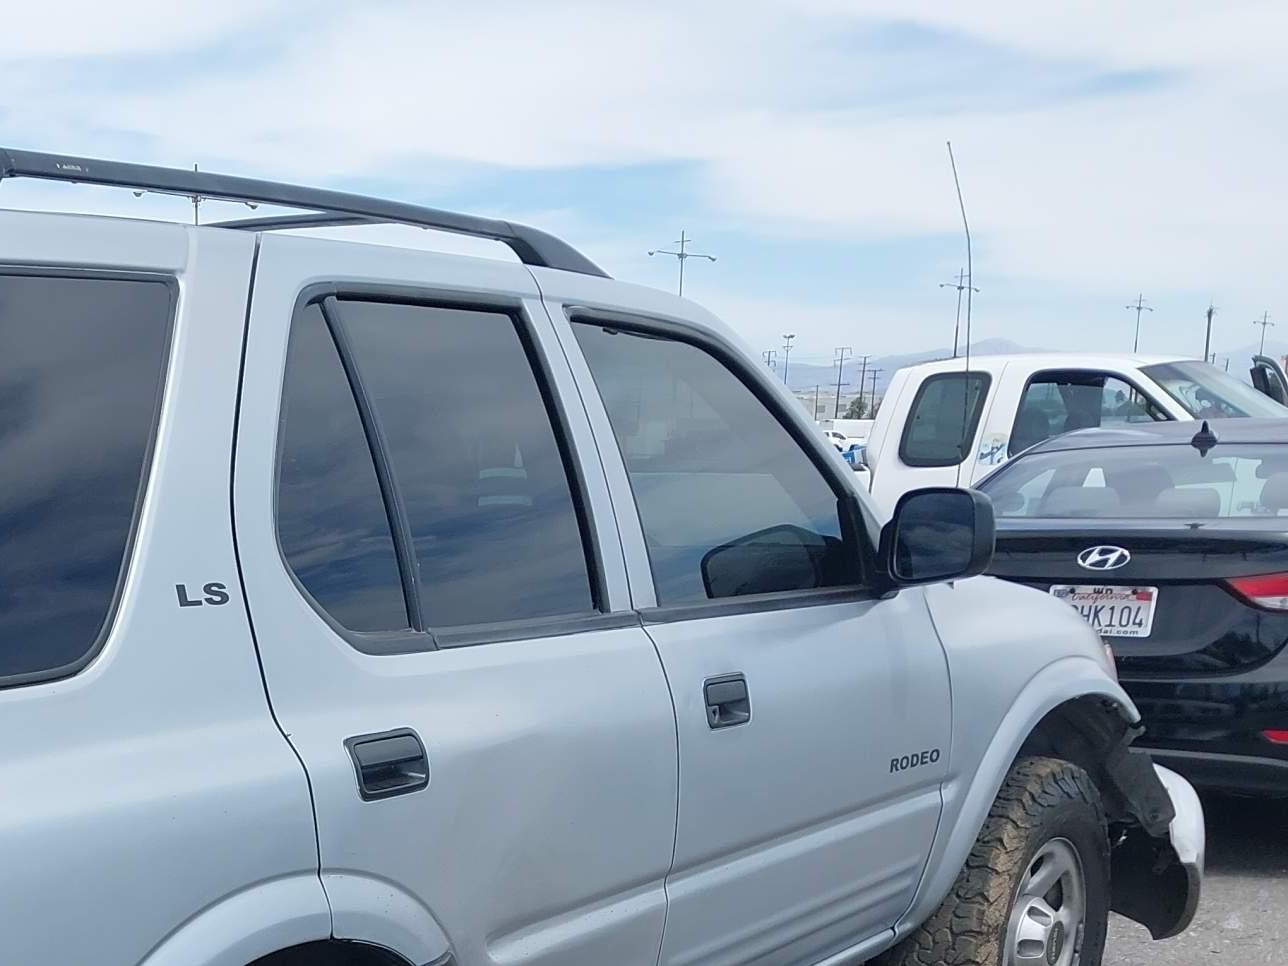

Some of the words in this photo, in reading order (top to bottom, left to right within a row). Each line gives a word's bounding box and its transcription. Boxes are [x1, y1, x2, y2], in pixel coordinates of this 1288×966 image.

[175, 582, 230, 607] LS
[1072, 604, 1144, 629] HK104
[889, 748, 940, 773] RODEO
